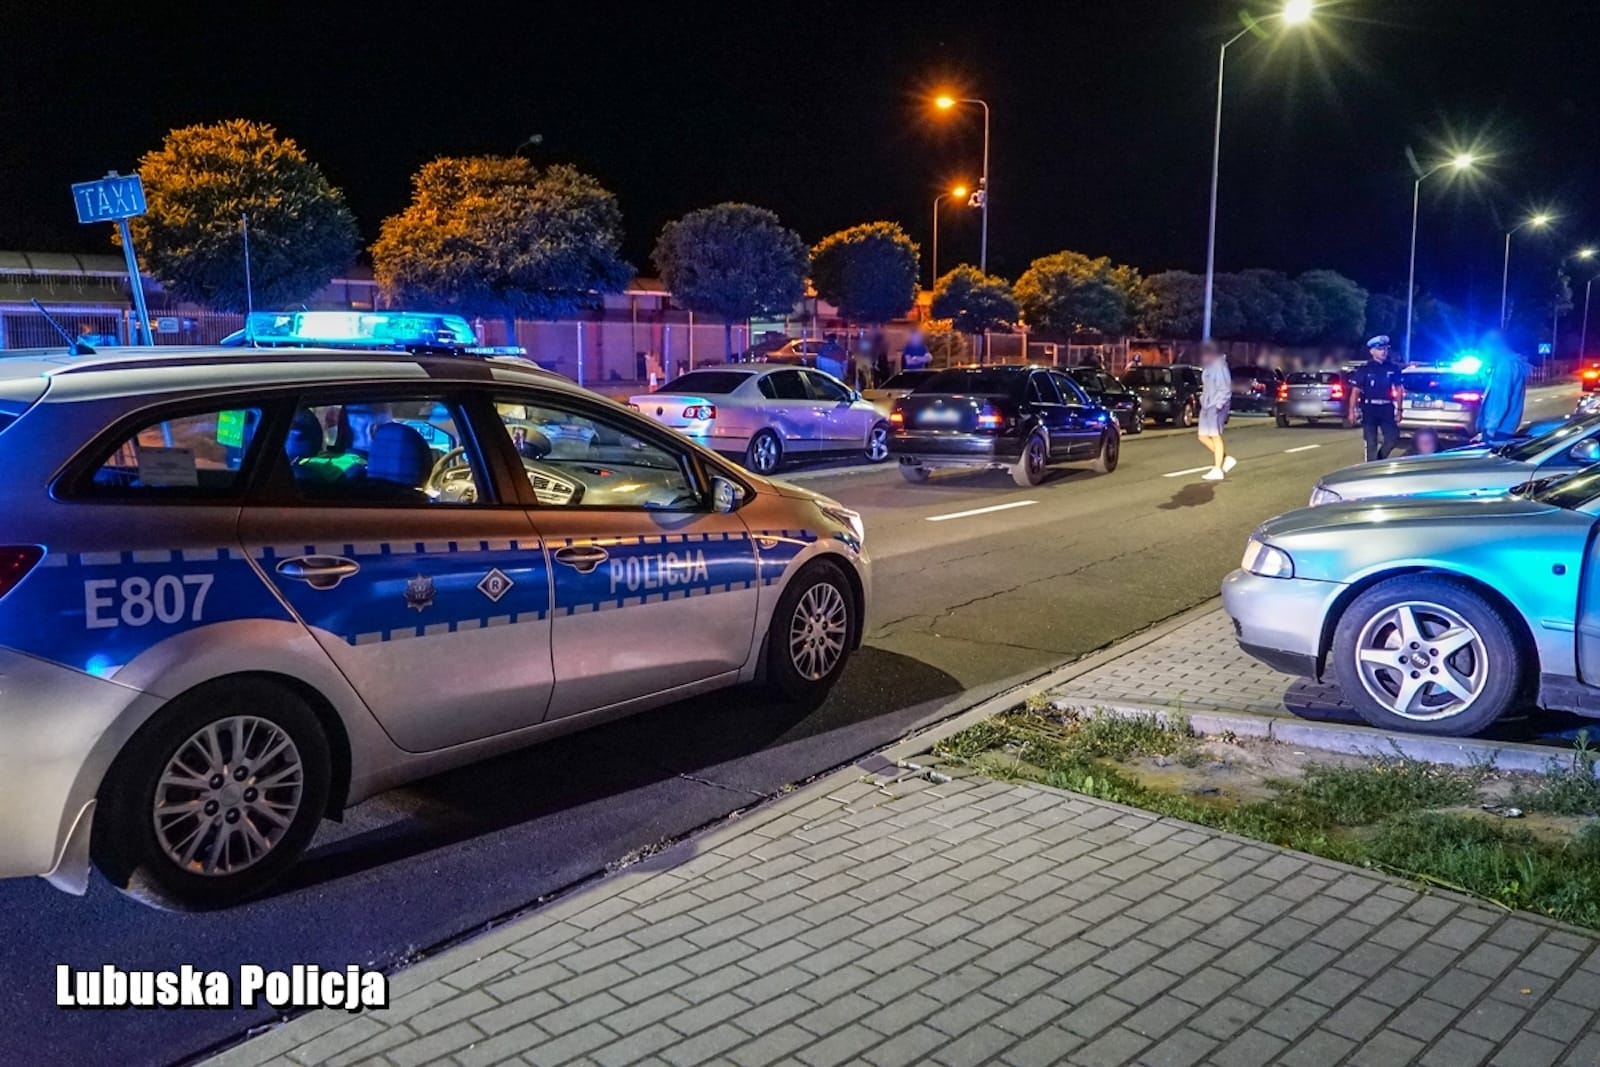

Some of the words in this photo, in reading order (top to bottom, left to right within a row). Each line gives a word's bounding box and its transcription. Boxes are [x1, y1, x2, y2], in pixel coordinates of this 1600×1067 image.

[80, 182, 138, 217] TAXI
[610, 549, 708, 594] POLICJA
[84, 574, 214, 629] E807
